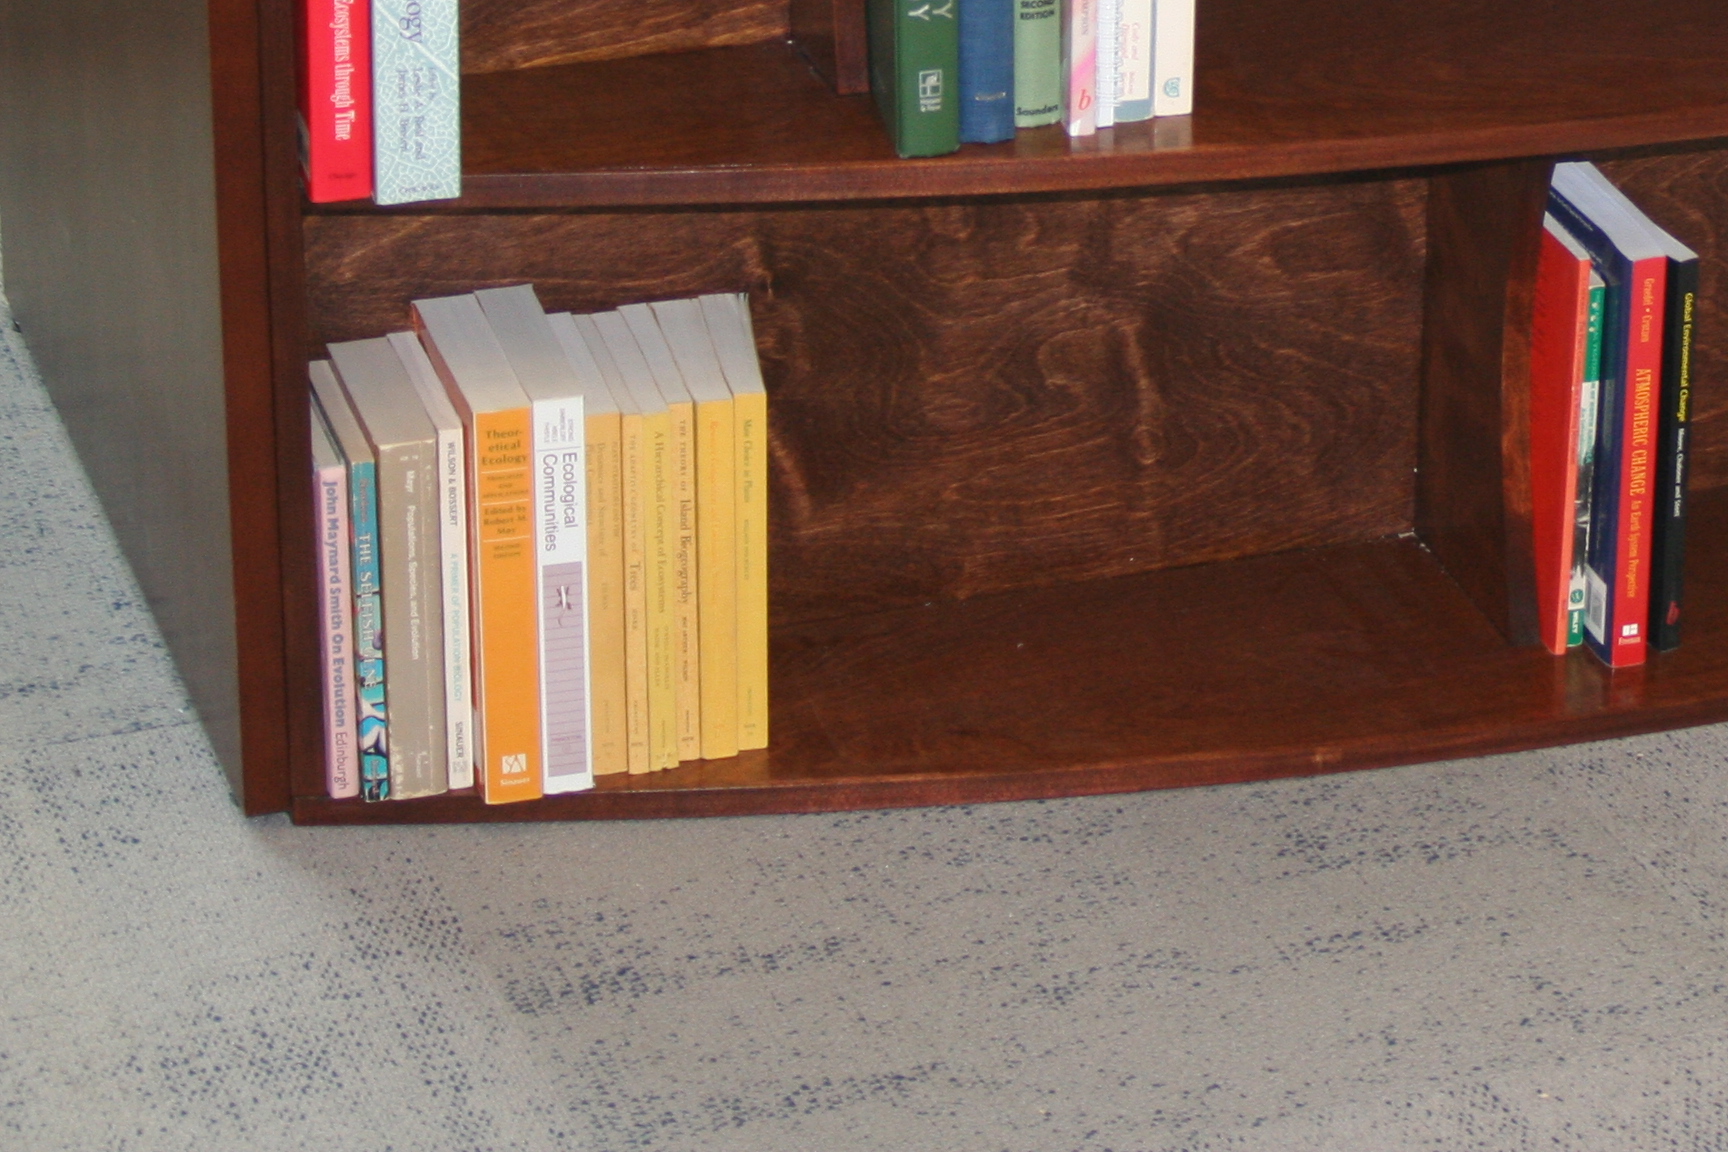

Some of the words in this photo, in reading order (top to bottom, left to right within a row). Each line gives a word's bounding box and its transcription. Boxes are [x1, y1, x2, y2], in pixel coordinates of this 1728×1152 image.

[329, 63, 355, 108] through
[333, 110, 356, 140] Time
[1682, 293, 1695, 321] Global
[1679, 323, 1693, 387] Environmental
[1631, 368, 1653, 446] ATMOSPHERIC
[1677, 389, 1690, 422] Change
[486, 429, 523, 440] Theor-
[488, 440, 521, 453] etical
[447, 442, 458, 475] WILSON
[482, 454, 528, 466] Ecology
[1629, 449, 1648, 496] CHANGE
[323, 481, 340, 516] John
[403, 470, 416, 493] Mayr
[559, 452, 578, 527] Ecological
[448, 487, 459, 526] BOSSERT
[543, 454, 559, 552] Communities
[680, 499, 693, 531] Island
[405, 505, 417, 559] Populations,
[653, 504, 667, 544] Concept
[325, 518, 343, 584] Maynard
[359, 532, 373, 566] THE
[450, 561, 460, 595] PRIMER
[628, 561, 642, 592] Trees
[656, 559, 669, 614] Ecosystems
[676, 535, 695, 605] Biogeography
[330, 587, 344, 630] Smith
[360, 572, 376, 643] SELFISH
[409, 601, 418, 617] and
[451, 597, 460, 608] OF
[332, 633, 345, 654] On
[409, 619, 421, 661] Evolution
[451, 611, 462, 661] POPULATION
[334, 657, 348, 728] Evolution
[453, 664, 463, 702] BIOLOGY
[334, 732, 350, 792] Edinburgh
